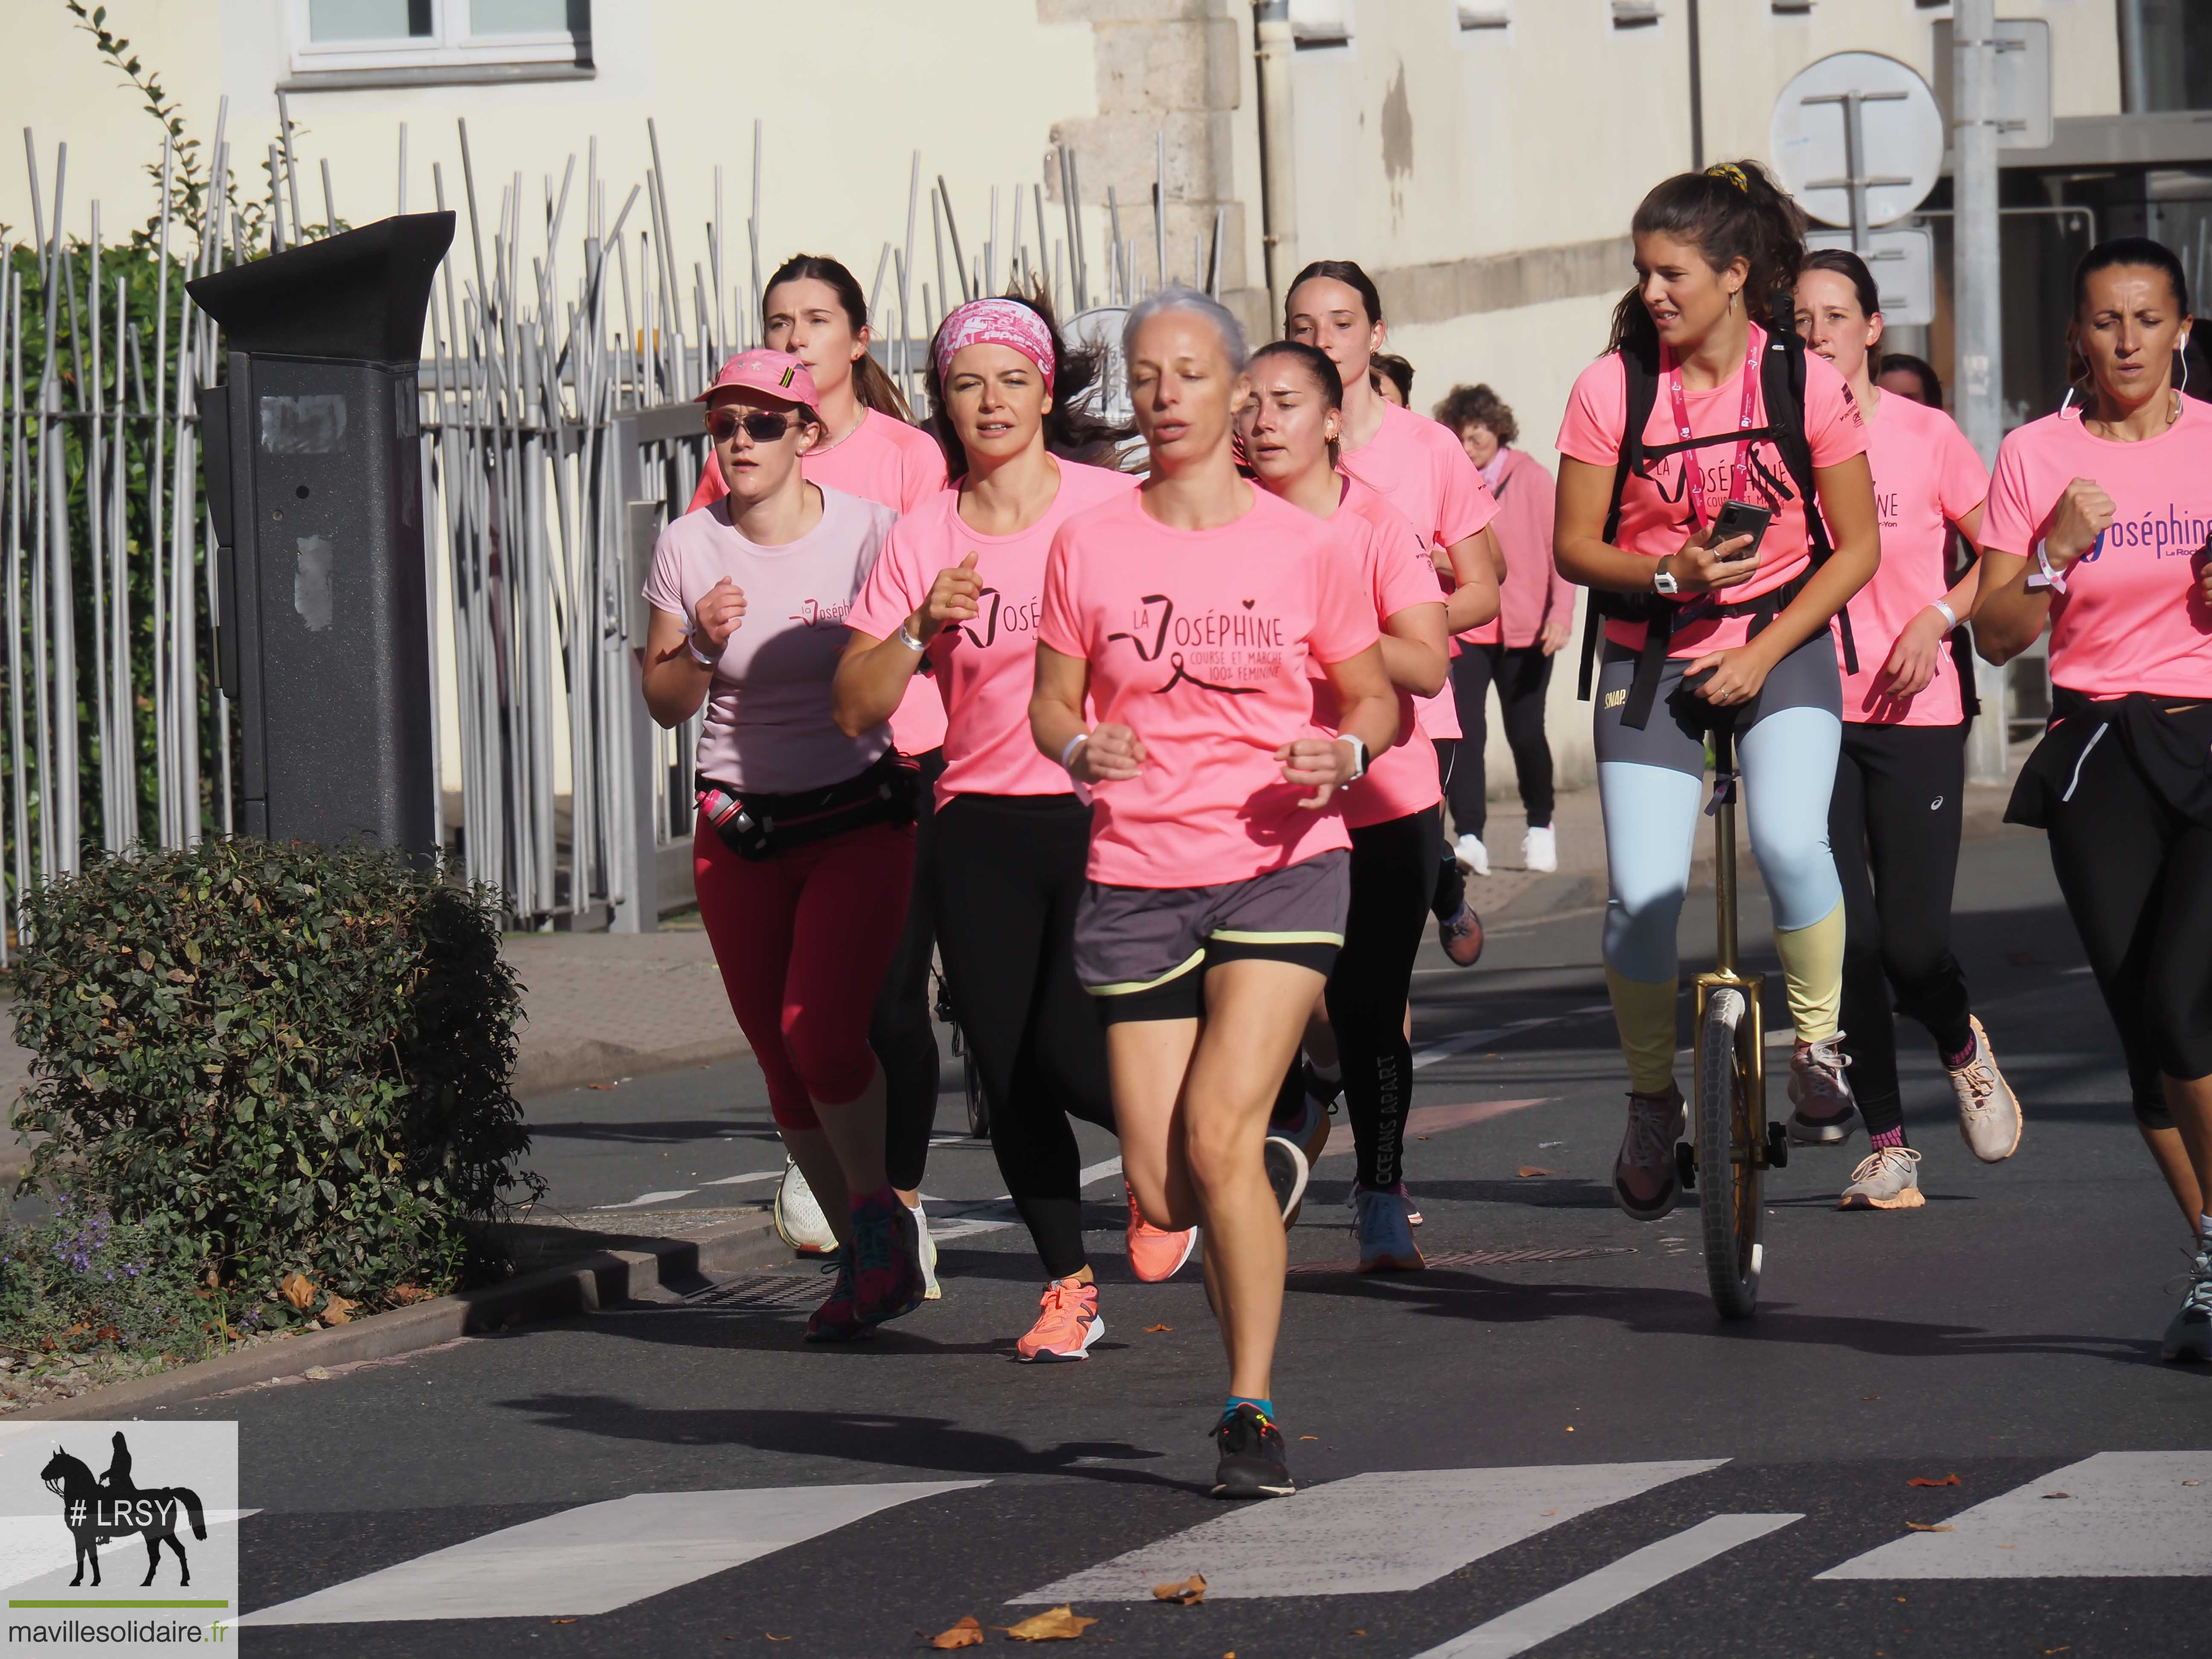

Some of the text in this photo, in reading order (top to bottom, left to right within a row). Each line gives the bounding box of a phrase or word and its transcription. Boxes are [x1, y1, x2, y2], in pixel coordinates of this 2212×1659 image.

[1133, 608, 1150, 630] LA
[1190, 652, 1282, 665] COURSE ET MARCHE
[1376, 1055, 1398, 1185] OCEANS APART
